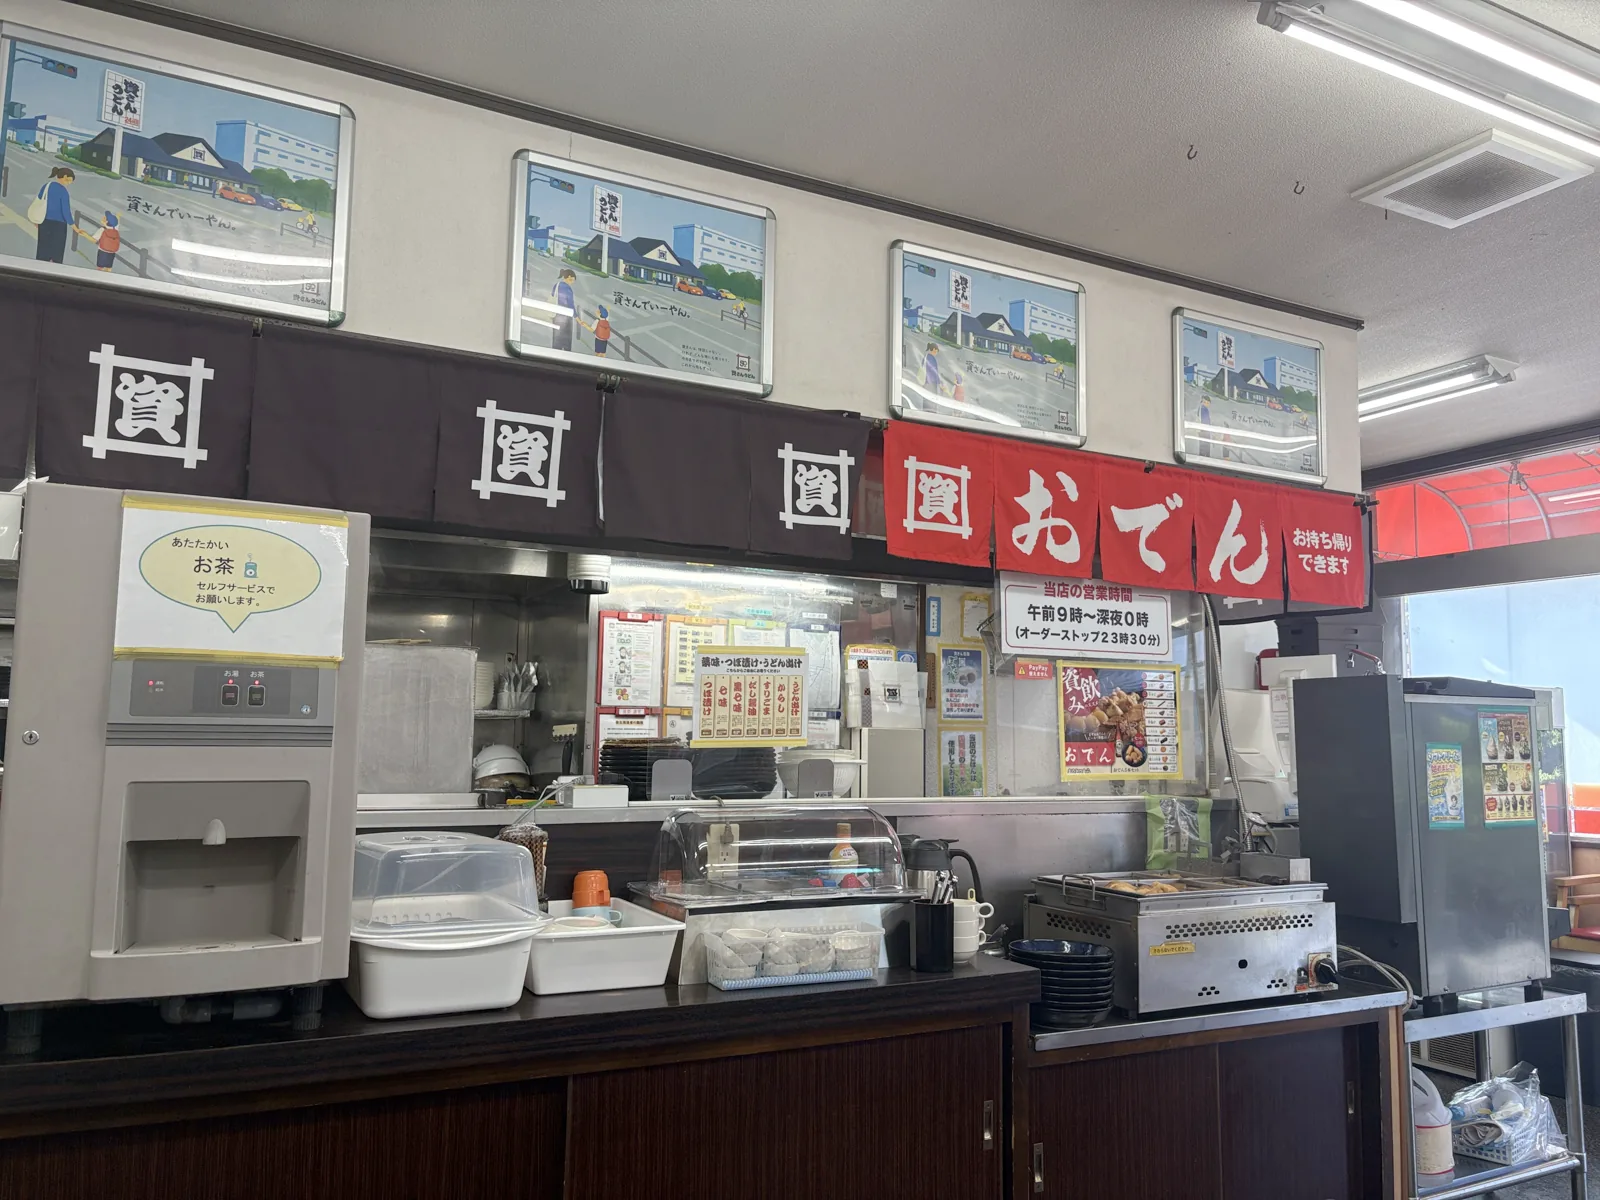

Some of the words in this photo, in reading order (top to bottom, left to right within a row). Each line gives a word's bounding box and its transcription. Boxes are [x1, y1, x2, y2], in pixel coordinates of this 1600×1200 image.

[112, 83, 123, 116] うどん
[127, 195, 236, 231] 資さんでいーやん。
[613, 291, 691, 319] 資さんでいーやん。
[965, 360, 1023, 382] 資さんでいーやん。
[115, 372, 185, 445] 資
[496, 422, 549, 487] 資
[794, 463, 839, 517] 資
[917, 471, 960, 525] 資
[1012, 468, 1270, 586] おでん
[172, 537, 229, 550] あたたかい
[1293, 528, 1352, 553] お持ち帰り
[193, 555, 235, 575] お茶
[1298, 554, 1350, 576] できます
[195, 594, 260, 607] お願いします。
[197, 581, 276, 595] セルフサービスで
[1044, 581, 1133, 604] 当店の営業時間
[1028, 664, 1049, 672] PayPay
[718, 685, 728, 708] 七味
[763, 681, 771, 716] すりごま
[777, 683, 786, 713] からし
[1065, 746, 1111, 764] おでん
